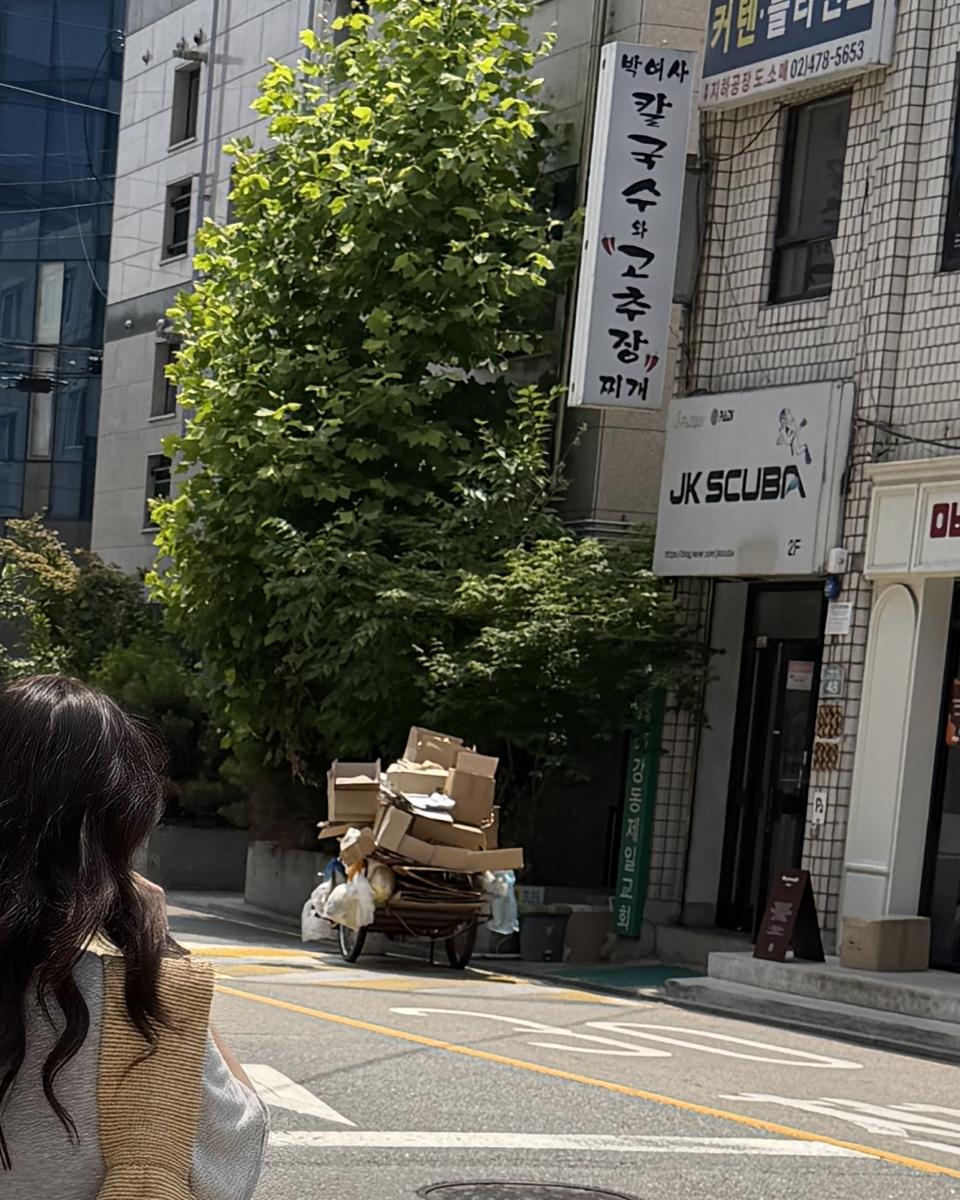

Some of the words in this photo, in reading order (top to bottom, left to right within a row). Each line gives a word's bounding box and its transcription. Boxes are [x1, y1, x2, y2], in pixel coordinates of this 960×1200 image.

[621, 53, 690, 84] 박여사
[710, 71, 752, 101] 지하공장
[789, 40, 866, 79] 02)478-5653
[599, 374, 649, 401] 찌개
[669, 471, 703, 505] JK
[704, 464, 807, 504] SCUBA
[787, 538, 802, 557] 2F
[616, 756, 646, 933] 강동제일교회
